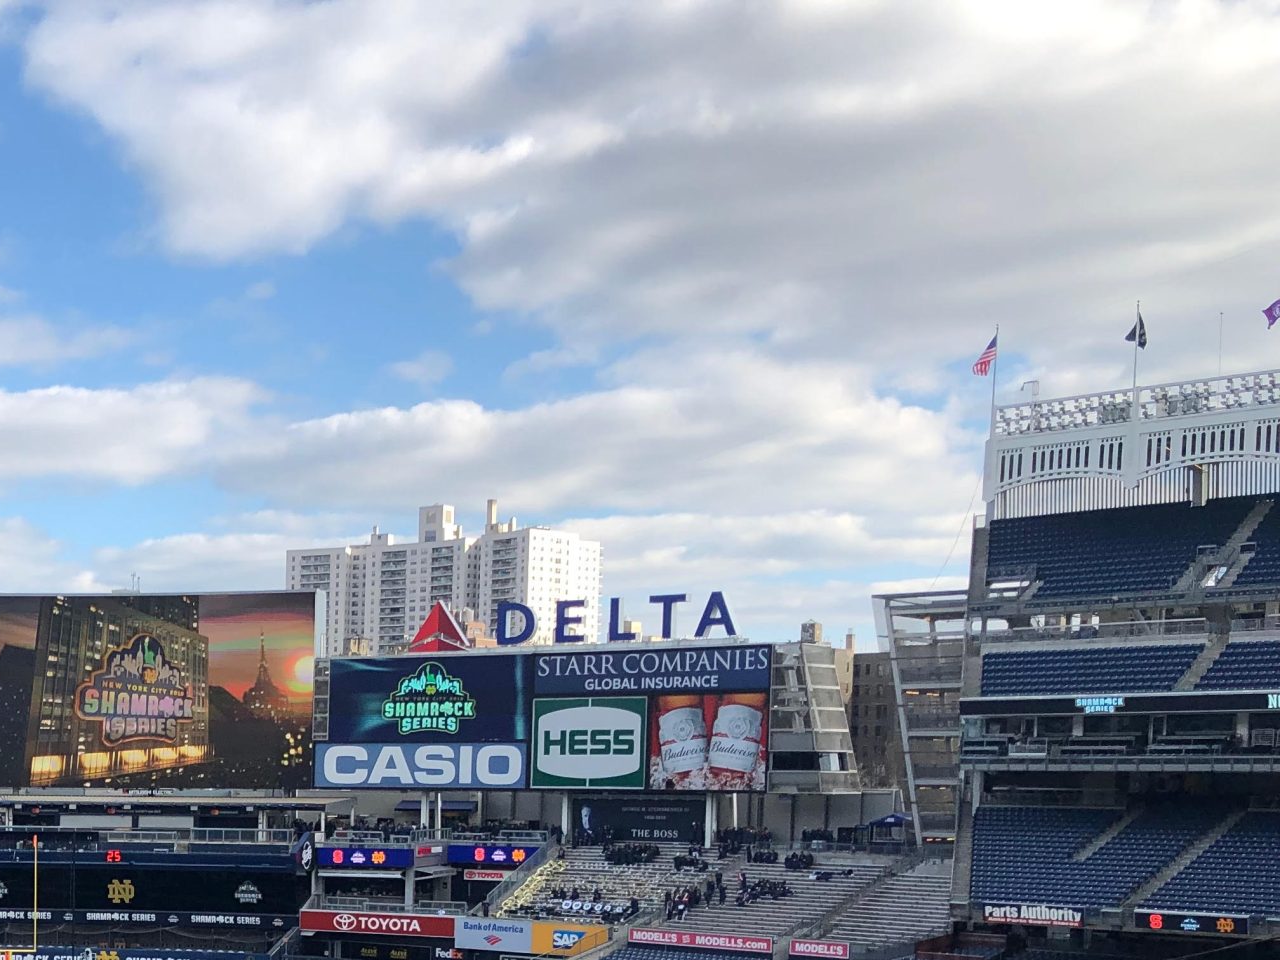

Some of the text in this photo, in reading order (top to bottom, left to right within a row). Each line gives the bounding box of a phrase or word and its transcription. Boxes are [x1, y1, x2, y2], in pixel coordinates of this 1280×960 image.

[496, 590, 737, 646] DELTA
[538, 648, 769, 677] STARR COMPANIES
[102, 680, 122, 689] NEW
[127, 684, 148, 693] YORK
[584, 675, 719, 691] GLOBAL INSURANCE
[402, 717, 457, 731] SERIES
[543, 729, 635, 755] HESS
[323, 745, 522, 784] CASIO
[631, 829, 679, 838] THE BOSS
[107, 851, 121, 862] 25
[132, 913, 156, 922] SERIES
[985, 904, 1082, 922] Parts Authority
[237, 916, 261, 925] SERIES
[359, 916, 421, 932] TOYOTA
[464, 922, 524, 933] Bank of America
[553, 933, 579, 946] SAP
[633, 930, 677, 943] MODELL'S
[696, 935, 767, 950] MODELLS.com
[435, 948, 463, 959] FedEx
[795, 943, 844, 955] MODELL'S
